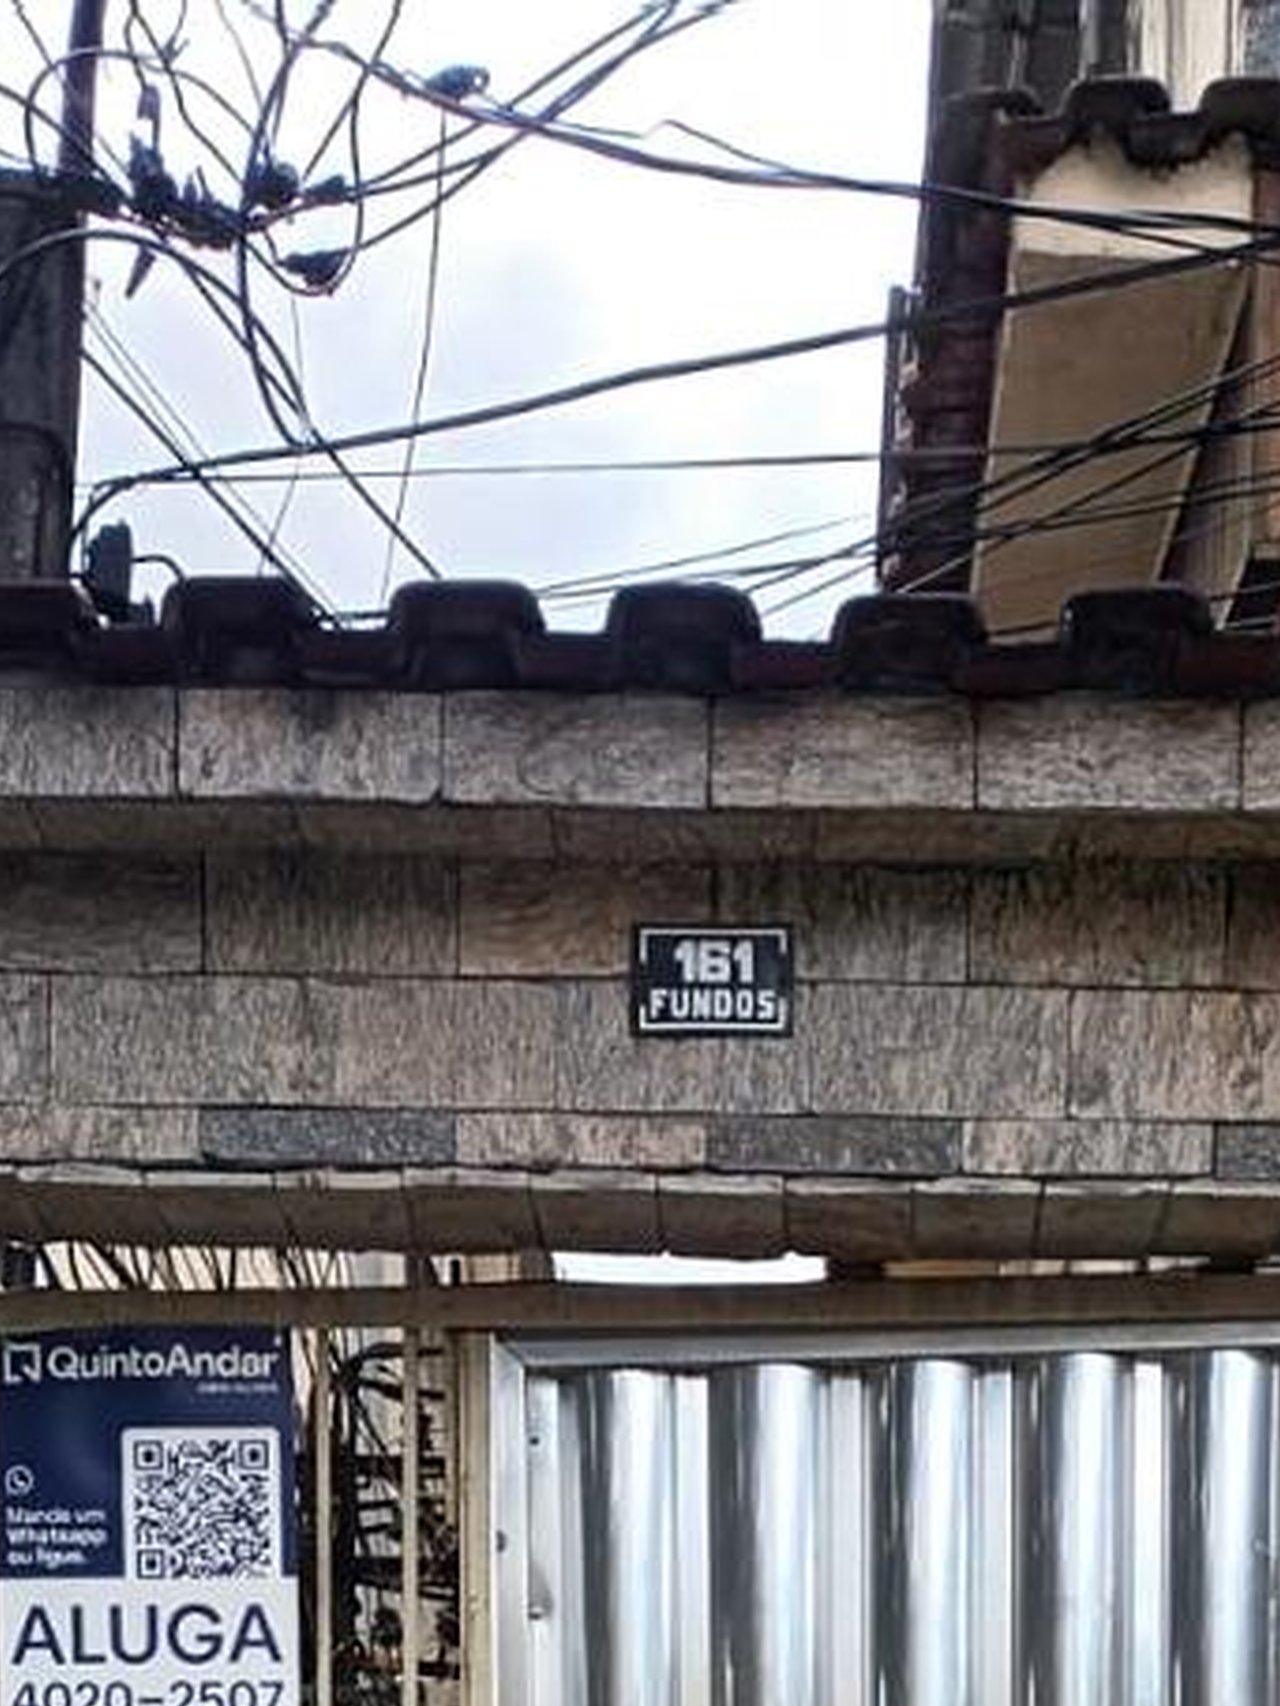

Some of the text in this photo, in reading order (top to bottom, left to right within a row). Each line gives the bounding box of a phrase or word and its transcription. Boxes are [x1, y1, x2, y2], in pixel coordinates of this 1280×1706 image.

[674, 940, 754, 983] 161
[650, 988, 776, 1020] FUNDOS
[47, 1344, 279, 1379] QuintoAndar
[12, 1605, 283, 1665] ALUGA
